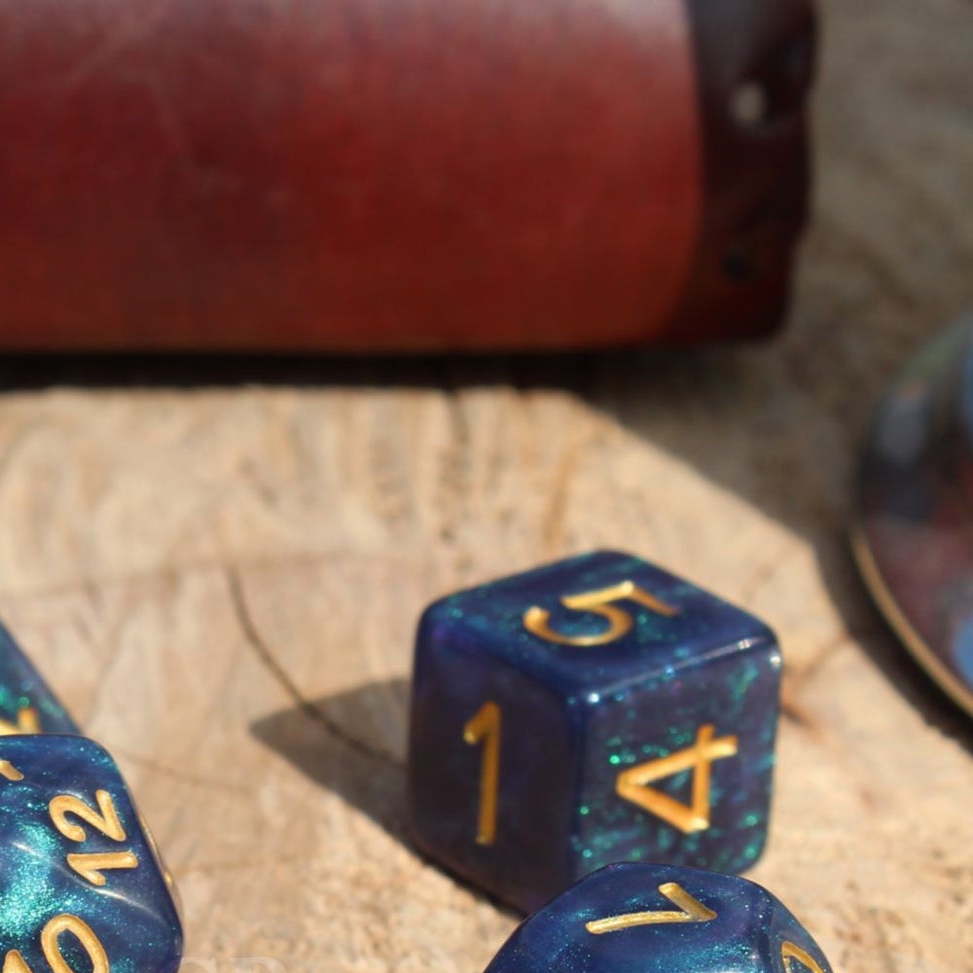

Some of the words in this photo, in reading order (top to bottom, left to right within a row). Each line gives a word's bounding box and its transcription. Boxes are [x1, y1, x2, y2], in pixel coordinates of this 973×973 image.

[522, 580, 682, 646] 5
[463, 701, 502, 845] 1
[615, 724, 739, 834] 4
[48, 789, 139, 885] 12
